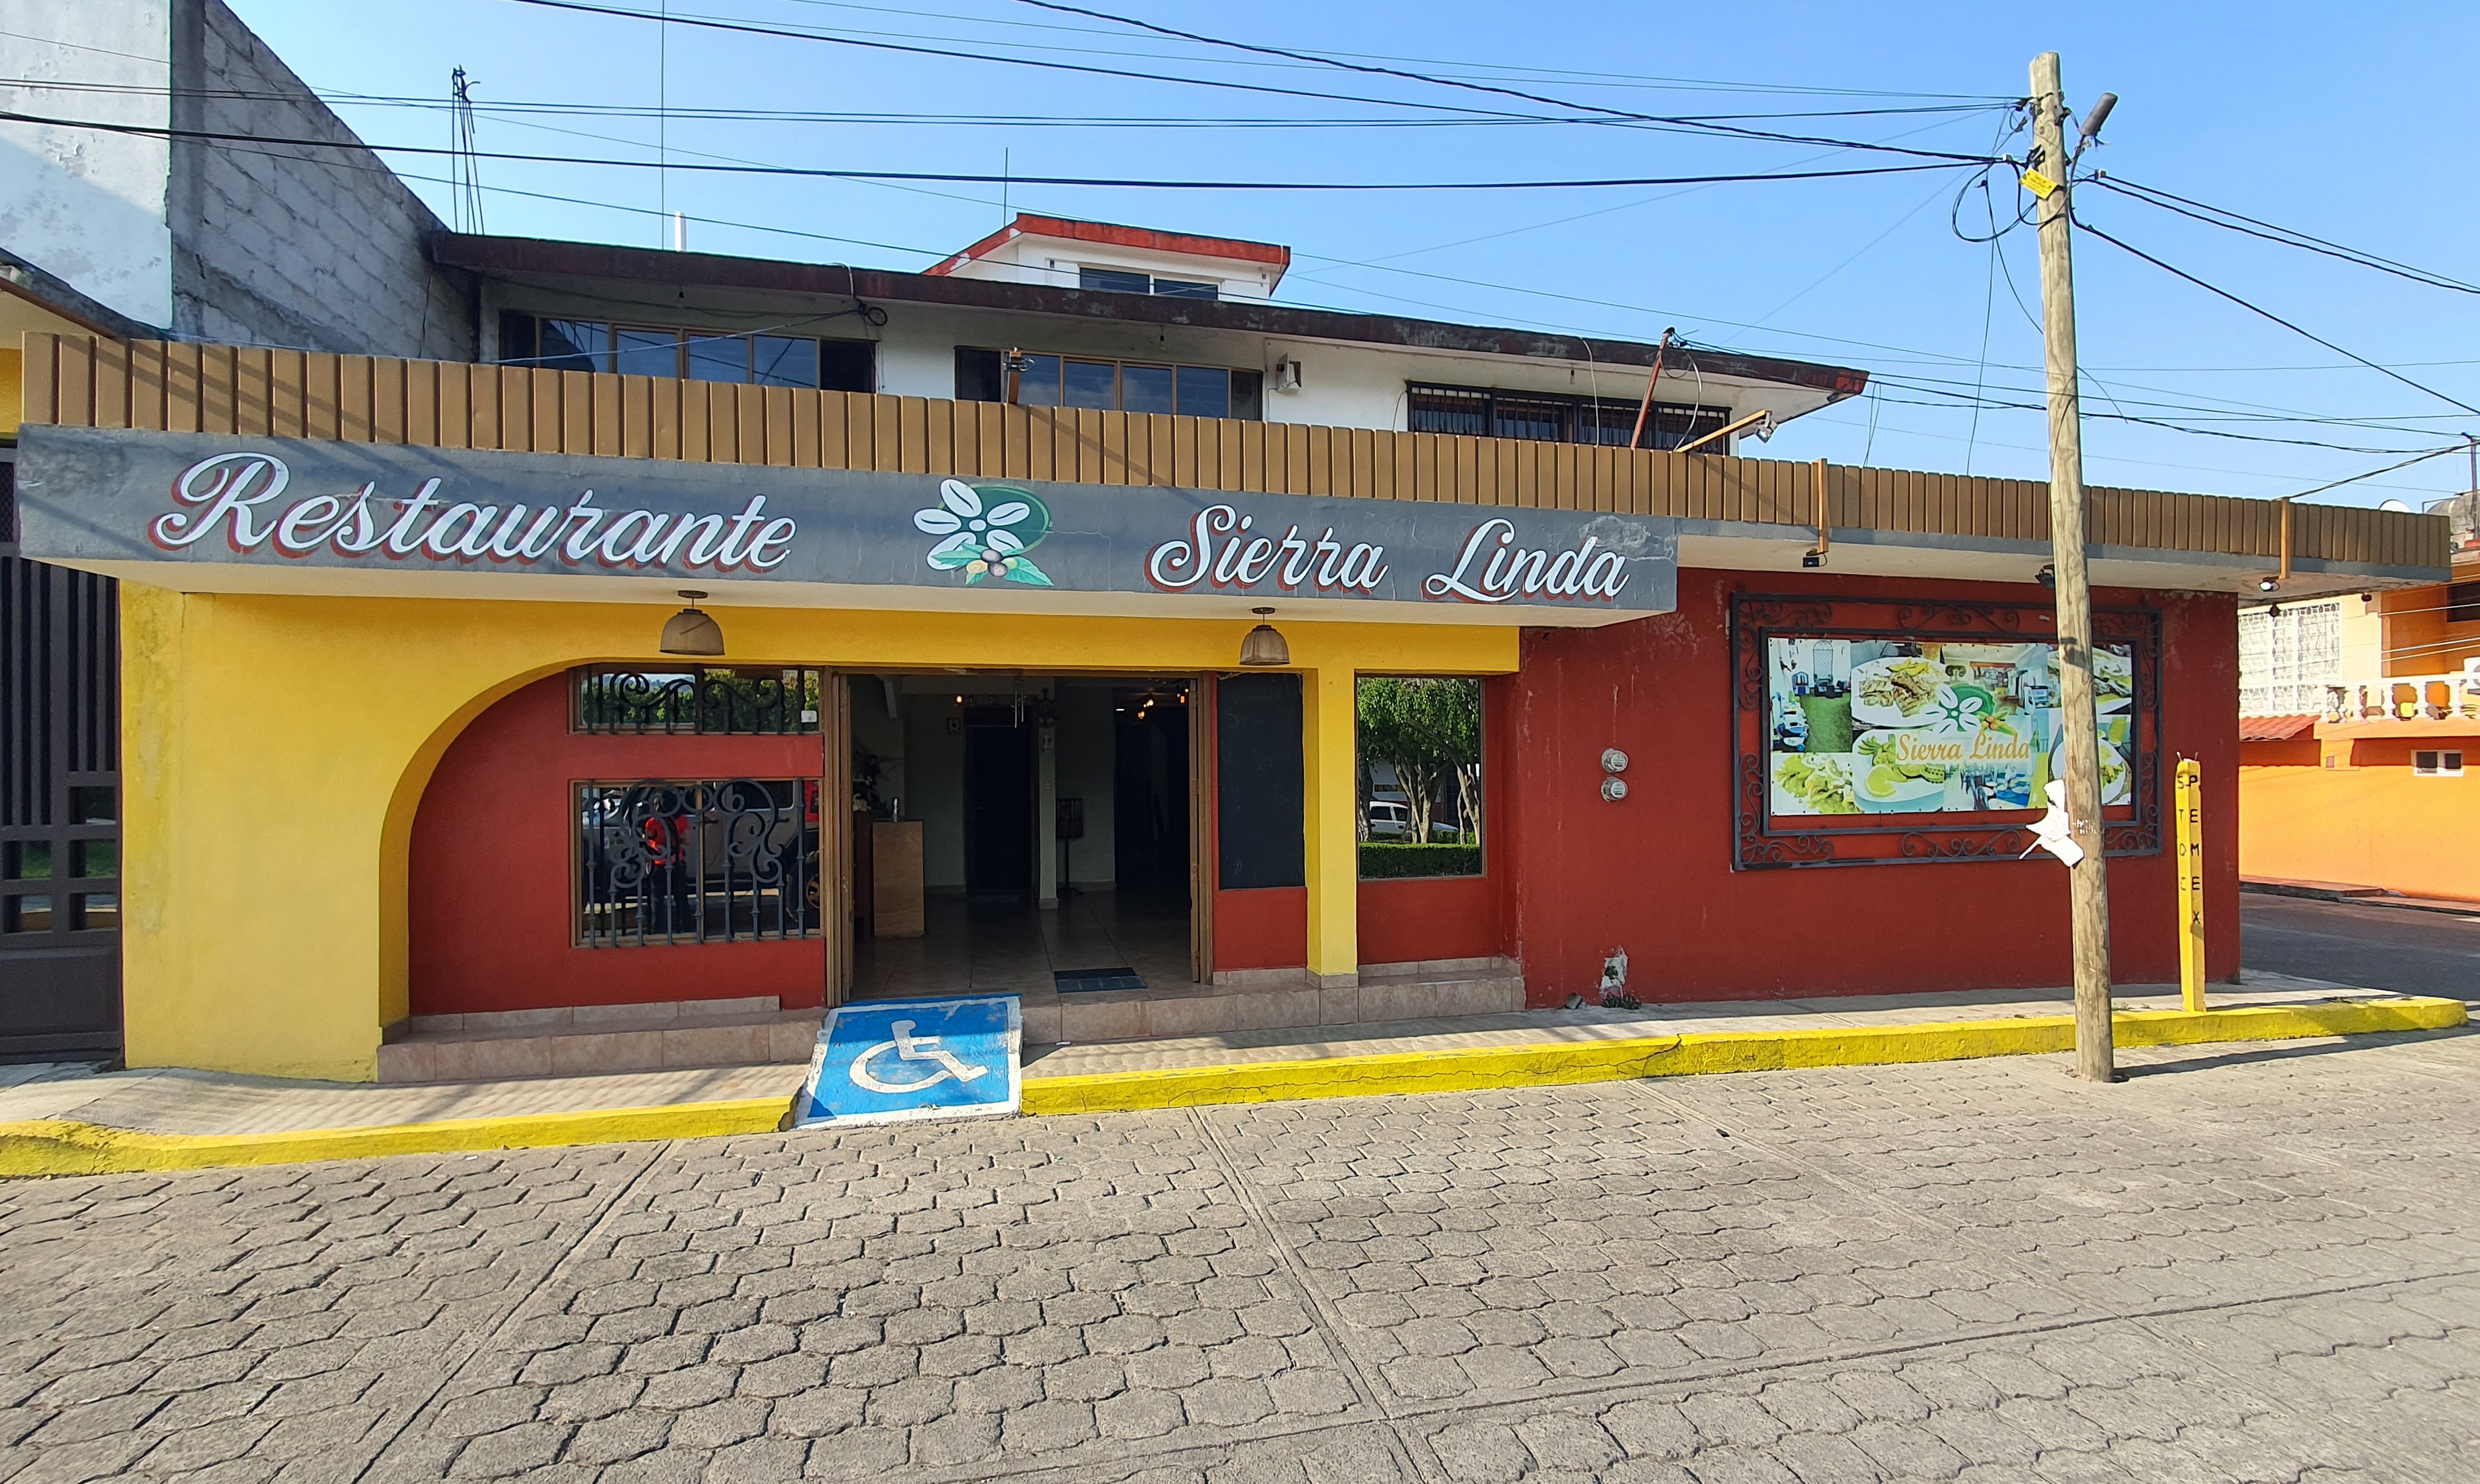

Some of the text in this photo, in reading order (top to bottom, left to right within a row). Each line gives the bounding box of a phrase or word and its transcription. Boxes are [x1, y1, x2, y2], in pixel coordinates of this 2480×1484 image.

[149, 451, 1629, 602] Restaurante Sierra Linda
[1896, 732, 2030, 761] Sierra Linda
[2188, 774, 2201, 925] PEMEX
